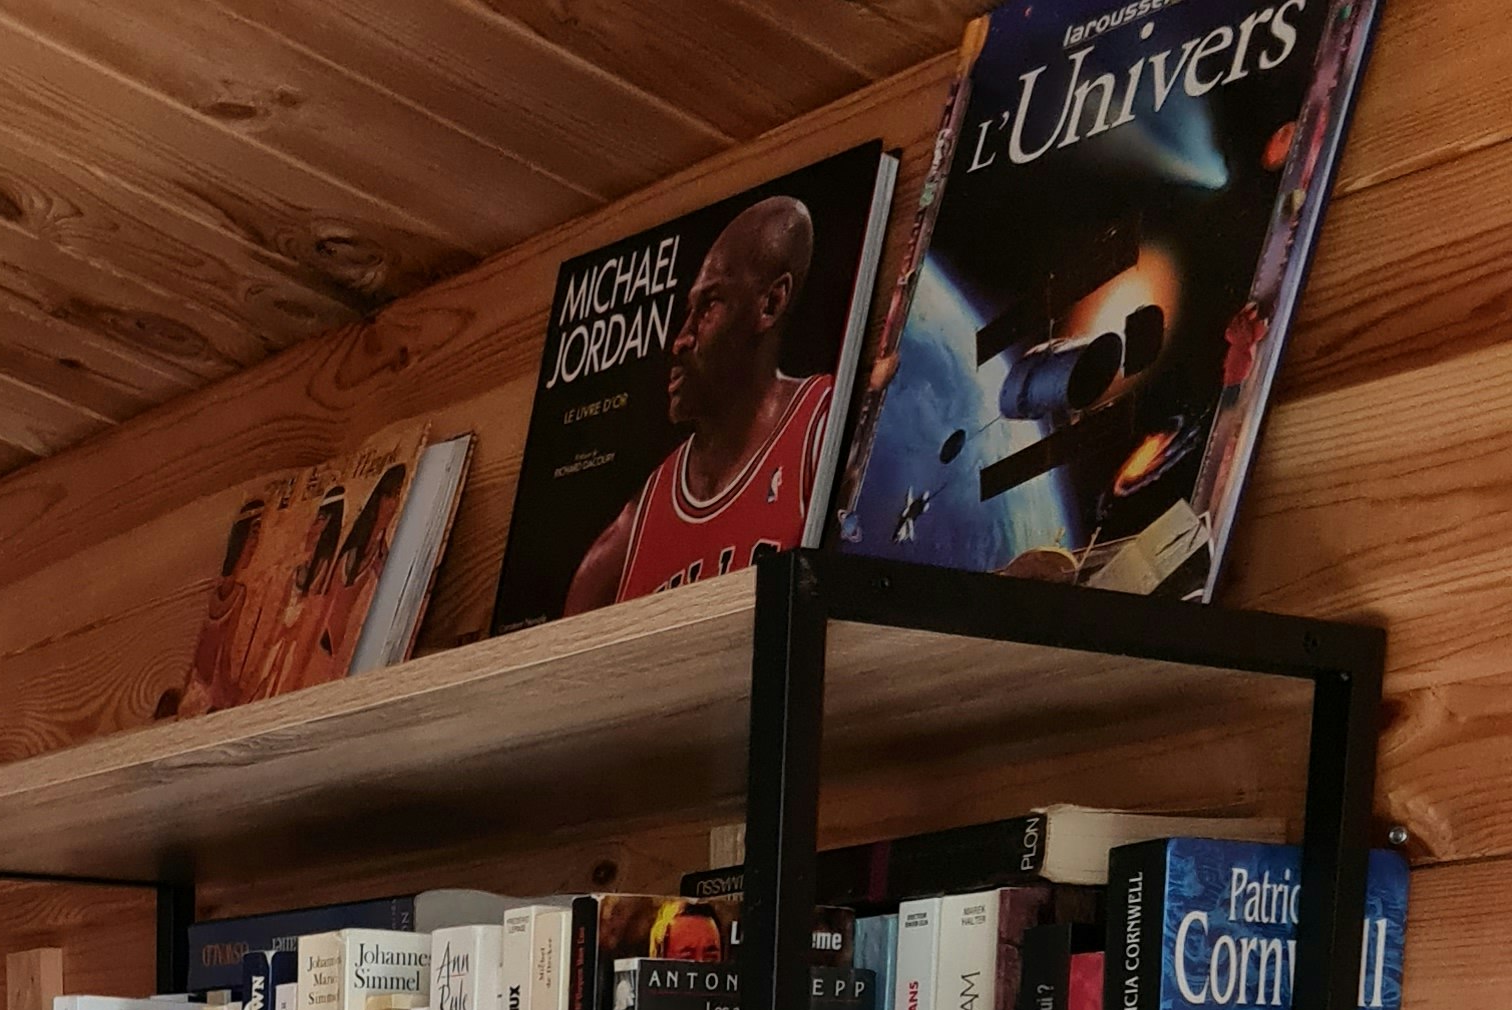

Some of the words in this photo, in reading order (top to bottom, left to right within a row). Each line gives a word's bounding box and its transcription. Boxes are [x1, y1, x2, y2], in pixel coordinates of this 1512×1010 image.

[967, 0, 1304, 174] L'Univers
[559, 235, 680, 327] MICHAEL
[546, 294, 675, 389] JORDAN
[1020, 816, 1039, 871] PLON
[1125, 871, 1143, 971] CORNWELL
[353, 968, 420, 993] Simmel
[908, 981, 919, 1005] ANS
